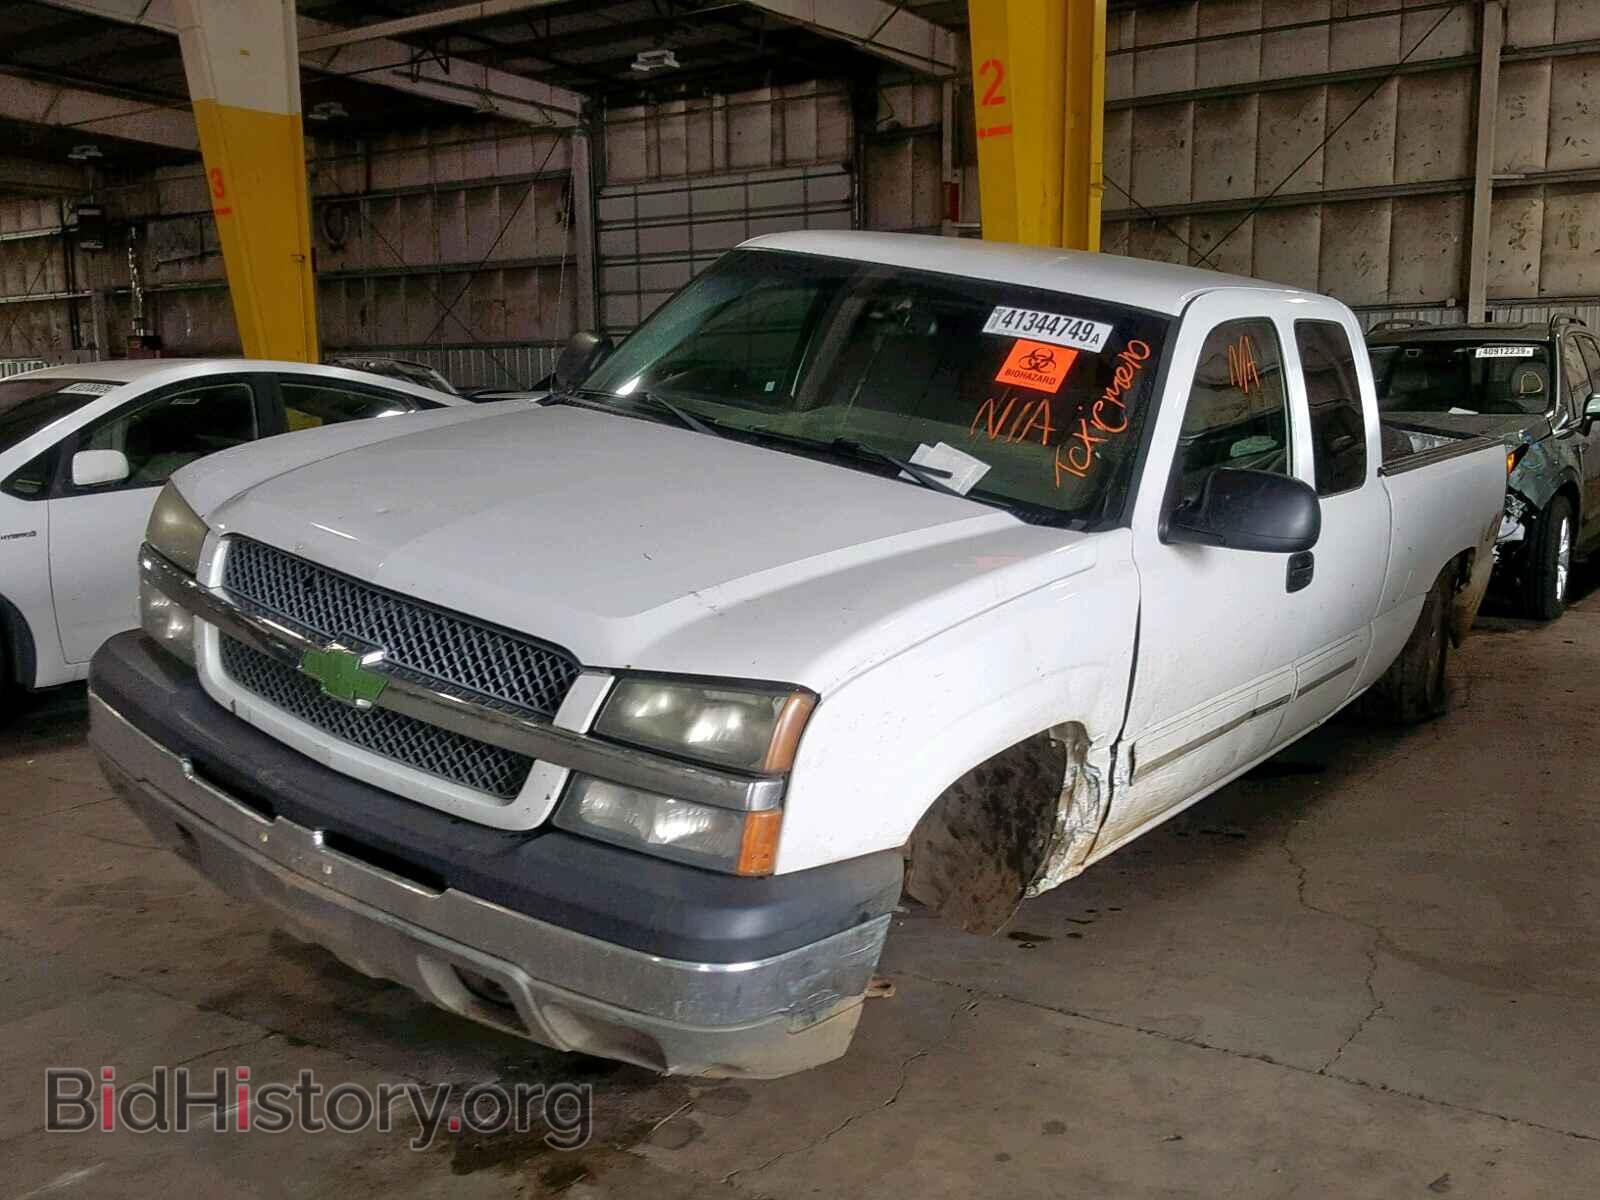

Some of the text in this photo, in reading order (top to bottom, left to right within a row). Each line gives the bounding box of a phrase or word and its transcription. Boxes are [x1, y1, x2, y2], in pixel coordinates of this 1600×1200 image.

[979, 58, 1007, 107] 2
[210, 167, 225, 199] 3
[1001, 309, 1095, 342] 41344749
[1004, 368, 1057, 385] BIOHAZARD
